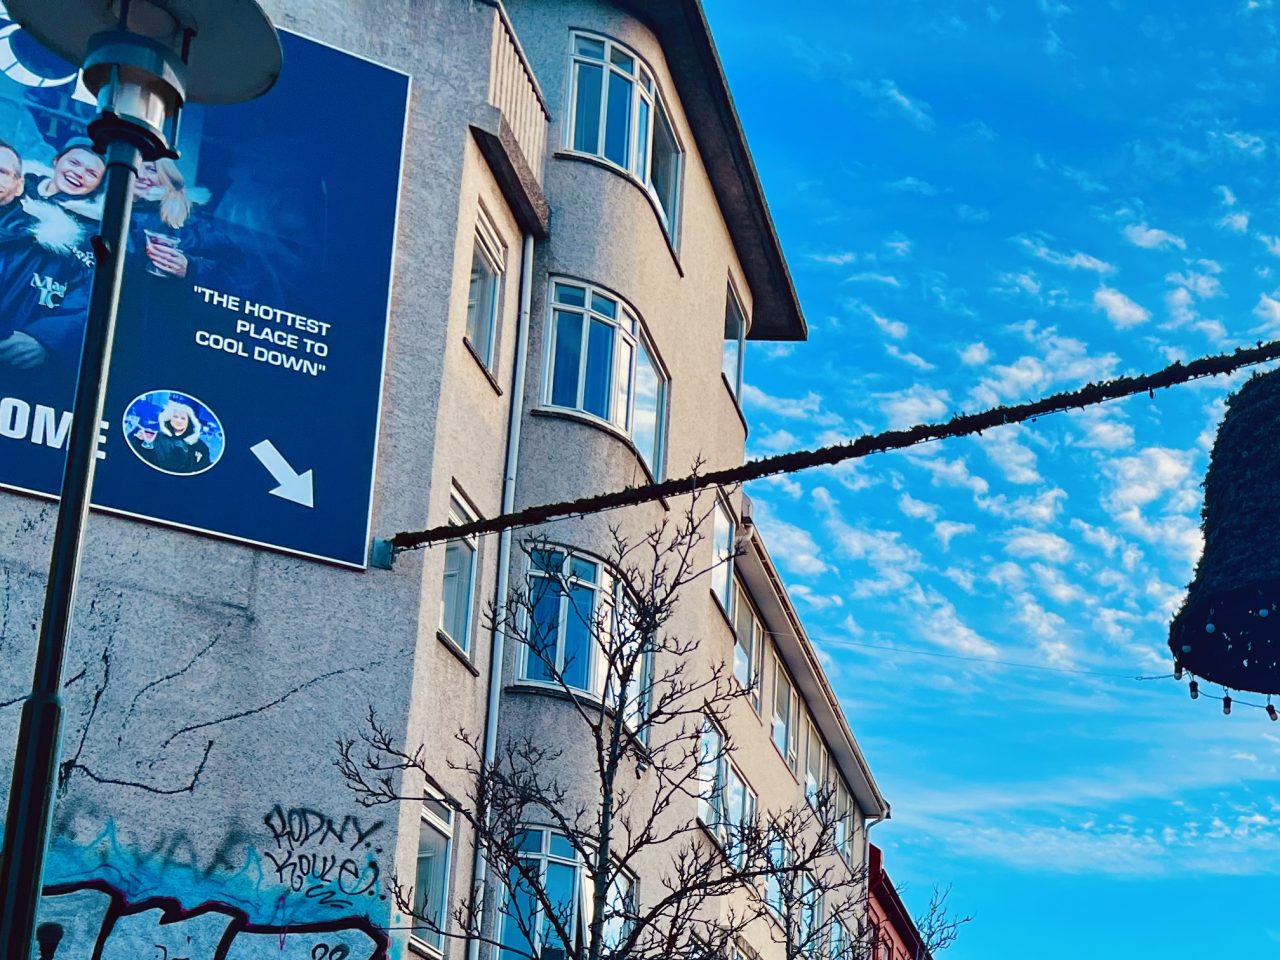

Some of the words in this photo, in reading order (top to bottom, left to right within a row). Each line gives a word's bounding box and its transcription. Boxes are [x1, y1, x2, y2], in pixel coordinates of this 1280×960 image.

[193, 284, 241, 311] "THE
[244, 300, 332, 337] HOTTEST
[195, 330, 250, 358] COOL
[253, 346, 327, 376] DOWN"
[236, 319, 299, 350] PLACE
[302, 338, 329, 357] TO
